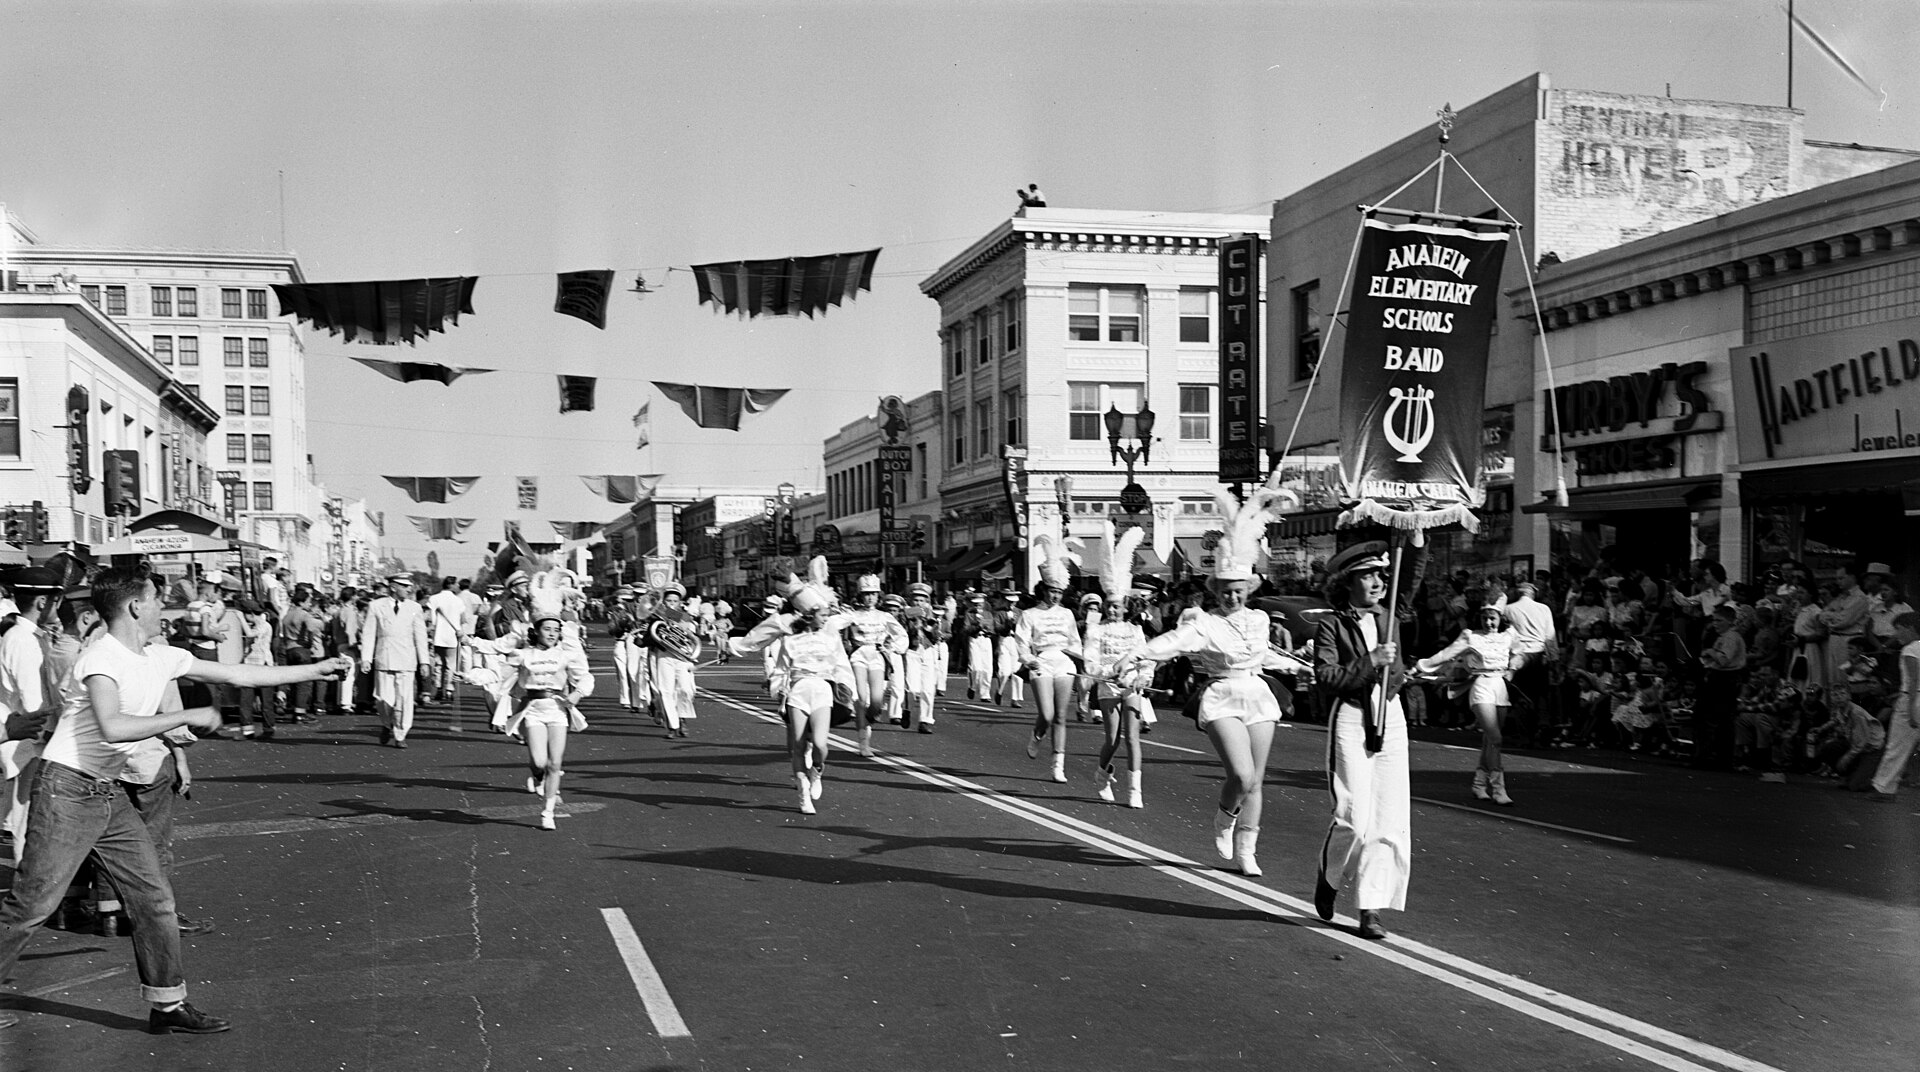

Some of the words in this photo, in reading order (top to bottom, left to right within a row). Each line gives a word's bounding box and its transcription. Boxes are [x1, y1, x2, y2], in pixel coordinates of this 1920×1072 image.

[1561, 140, 1690, 184] HOTEL
[1385, 244, 1471, 279] ANAHEIM
[1228, 249, 1246, 325] CUT
[1367, 275, 1479, 306] ELEMENTARY
[1382, 307, 1454, 334] SCHOOLS
[1383, 345, 1444, 373] BAND
[1228, 341, 1247, 441] RATE
[1750, 338, 1920, 459] HARTFIELD
[70, 408, 83, 485] CAFE
[881, 450, 911, 460] DUTCH
[1573, 437, 1676, 475] SHOES
[883, 461, 909, 471] BOY
[882, 473, 893, 529] PAINT
[1008, 458, 1020, 494] SEA
[1015, 502, 1028, 549] FOOD
[1121, 493, 1148, 504] STOP
[1361, 480, 1422, 499] ANAHEIM
